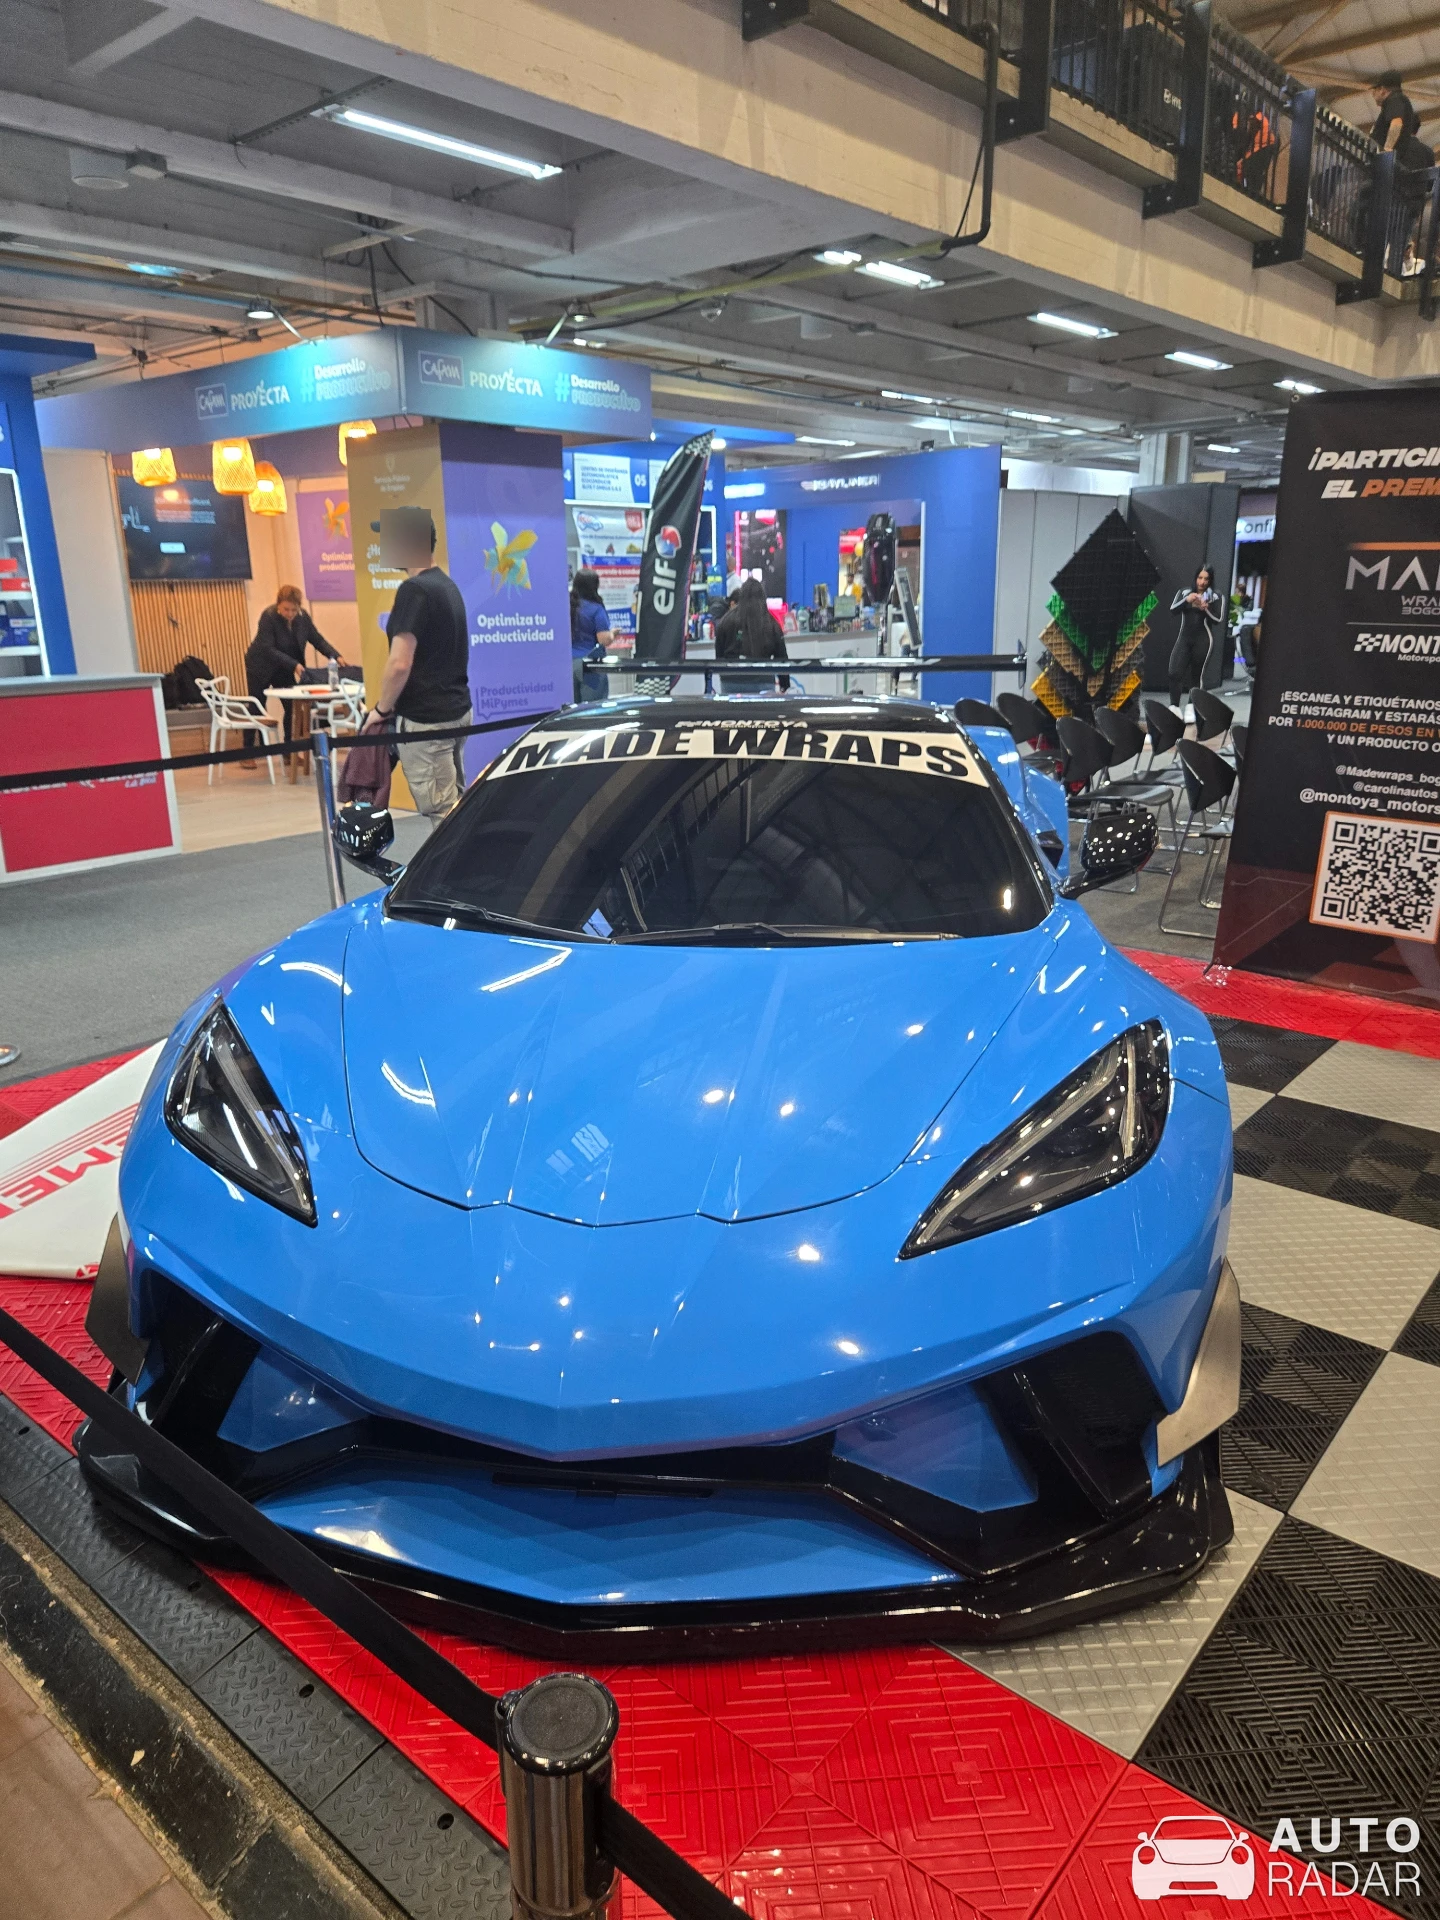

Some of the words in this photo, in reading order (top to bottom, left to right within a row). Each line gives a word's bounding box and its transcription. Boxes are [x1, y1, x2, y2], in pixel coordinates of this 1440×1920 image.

[570, 373, 620, 393] Desarrollo
[634, 474, 647, 487] 05
[1321, 479, 1357, 499] EL
[1345, 555, 1440, 591] MA
[652, 558, 677, 615] elf
[1401, 595, 1440, 607] WRA
[477, 612, 533, 630] Optimiza
[534, 613, 547, 626] tu
[470, 628, 554, 647] productividad
[480, 682, 554, 698] Productividad
[481, 697, 529, 710] MiPymes
[1281, 690, 1340, 705] ¡ESCANEA
[1343, 695, 1352, 704] Y
[1353, 694, 1440, 711] ETIQUÉTANOS
[1282, 704, 1298, 715] DE
[1300, 705, 1371, 720] INSTAGRAM
[1374, 711, 1382, 720] Y
[1385, 710, 1440, 725] ESTARÁS
[1268, 715, 1293, 727] POR
[1296, 718, 1347, 731] 1.000.000
[1350, 722, 1366, 733] DE
[1369, 724, 1413, 736] PESOS
[1416, 728, 1434, 738] EN
[1326, 733, 1335, 743] Y
[1337, 735, 1355, 745] UN
[1357, 736, 1428, 752] PRODUCTO
[505, 729, 695, 774] MADE
[712, 729, 969, 778] WRAPS
[1353, 781, 1438, 799] @carolinautos
